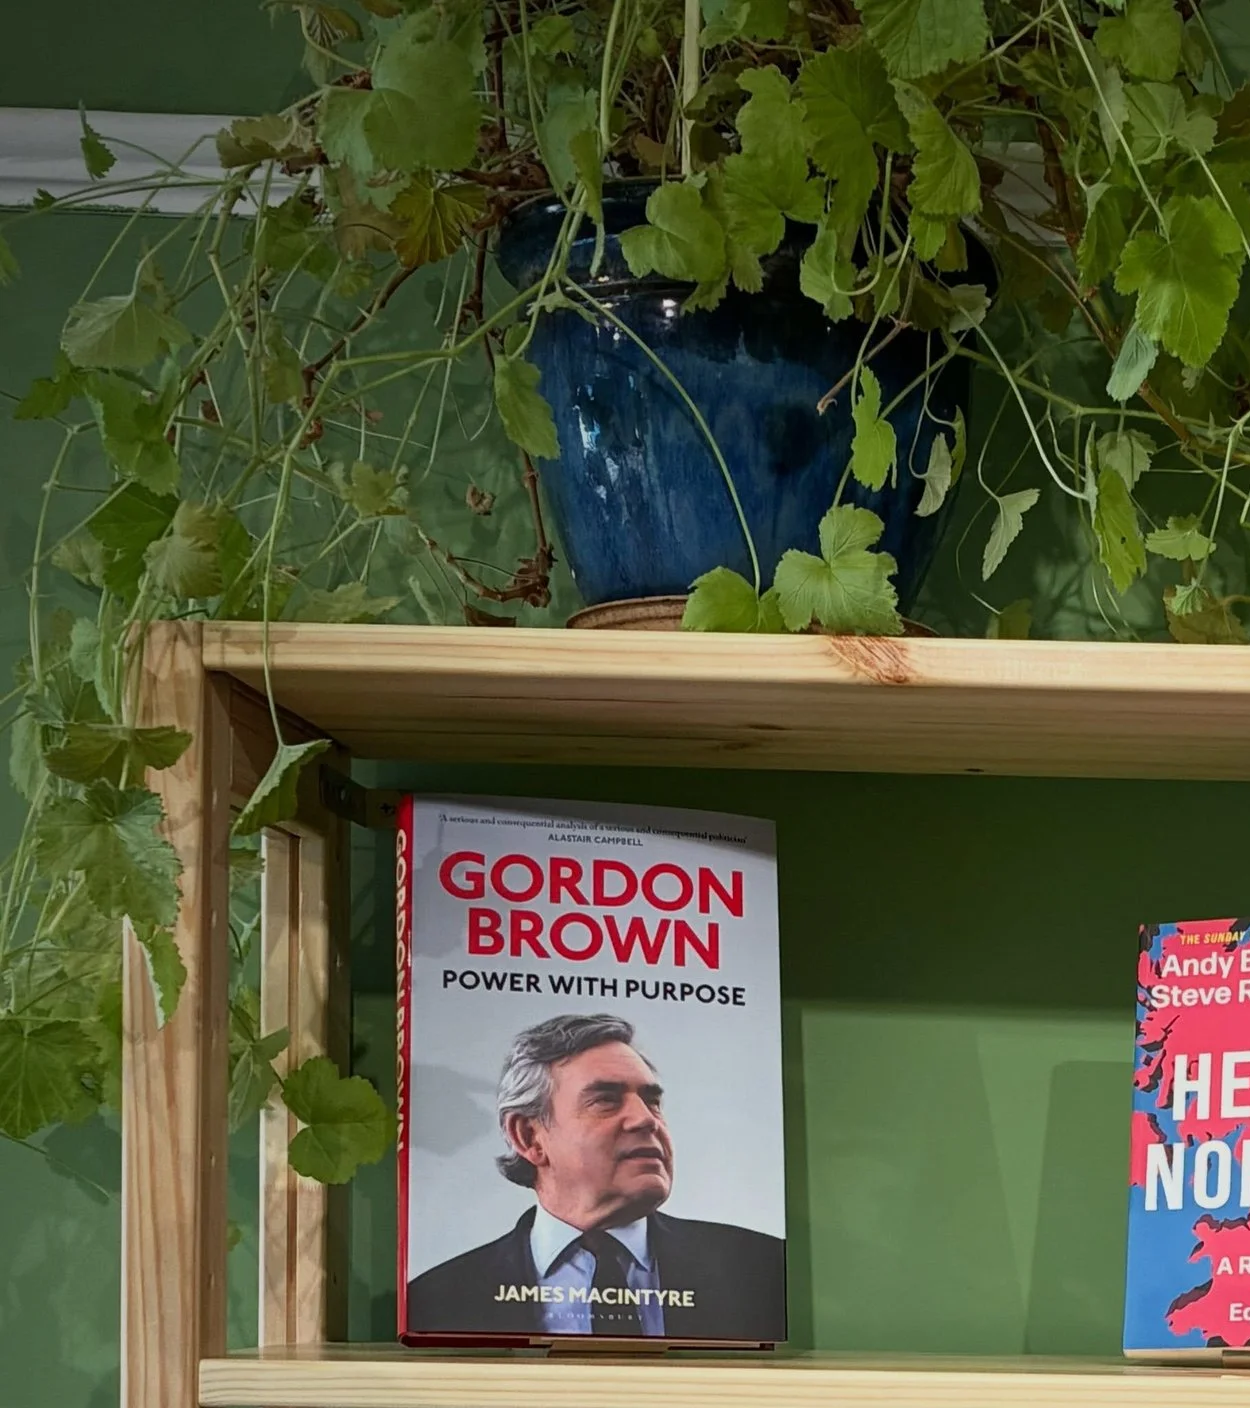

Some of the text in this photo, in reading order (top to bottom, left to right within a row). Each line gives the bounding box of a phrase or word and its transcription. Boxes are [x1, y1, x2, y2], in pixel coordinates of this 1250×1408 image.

[548, 833, 643, 847] ALASTAIR CAMPBELL
[439, 850, 743, 918] GORDON
[467, 907, 720, 970] BROWN
[1180, 934, 1200, 945] THE
[1203, 931, 1245, 944] SUNDAY
[1161, 951, 1234, 978] Andy
[442, 970, 746, 1006] POWER WITH PURPOSE
[1150, 983, 1232, 1009] Steve
[1216, 1257, 1233, 1275] A
[495, 1284, 695, 1307] JAMES MACINTYRE
